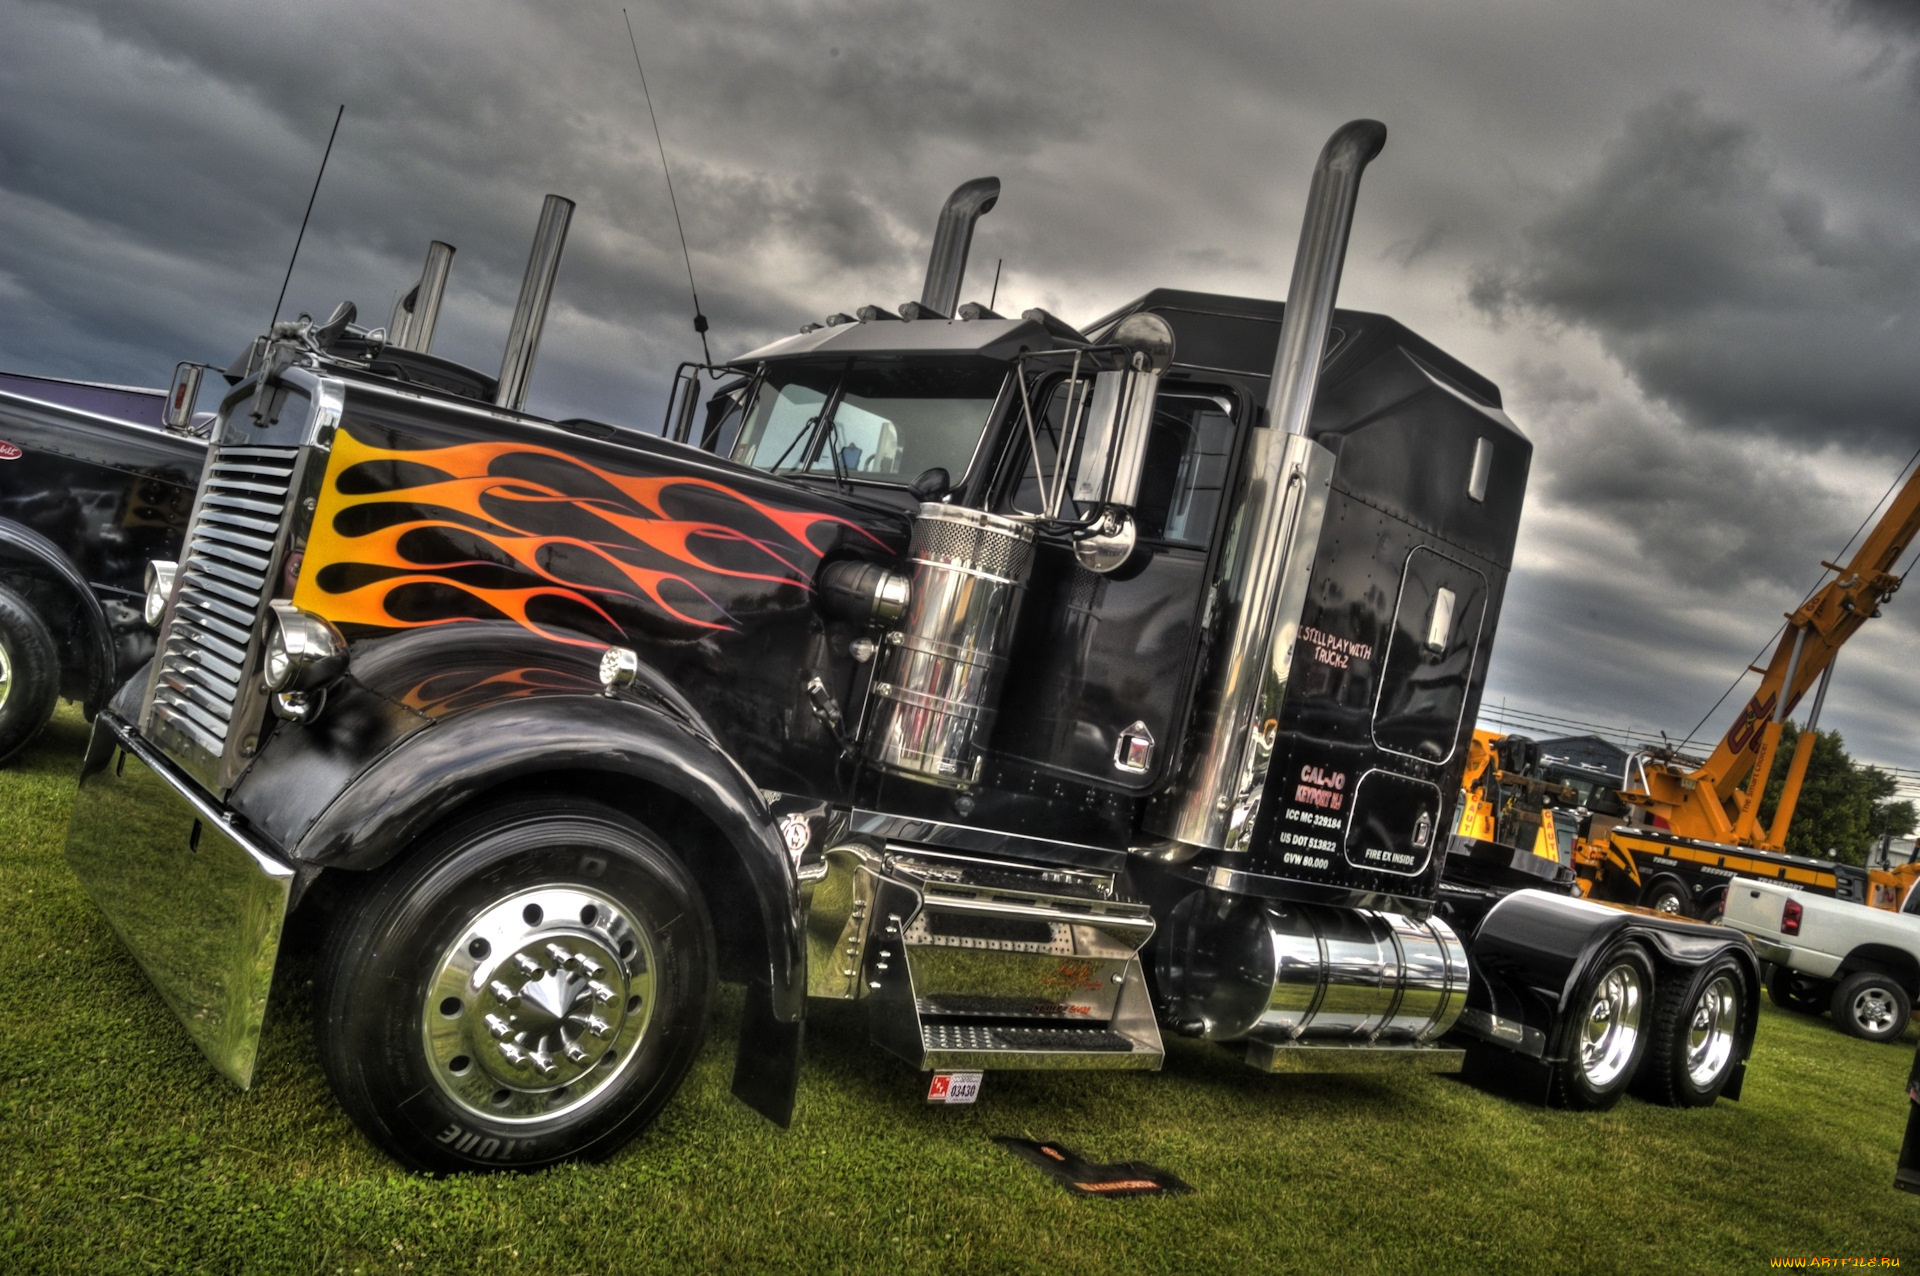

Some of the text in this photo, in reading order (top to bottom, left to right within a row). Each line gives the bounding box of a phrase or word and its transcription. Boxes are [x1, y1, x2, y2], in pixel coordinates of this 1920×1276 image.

[1303, 626, 1326, 647] STILL
[1327, 633, 1349, 653] PLAY
[1349, 641, 1372, 660] WITH
[1301, 764, 1345, 790] CAL-JO
[1285, 808, 1342, 830] ICC MC 329184
[1280, 832, 1337, 852] US DOT 513822
[1283, 852, 1303, 866] GVW
[1365, 848, 1415, 866] FIRE EX INSIDE
[1653, 856, 1678, 867] TOWING
[950, 1085, 976, 1098] 03430
